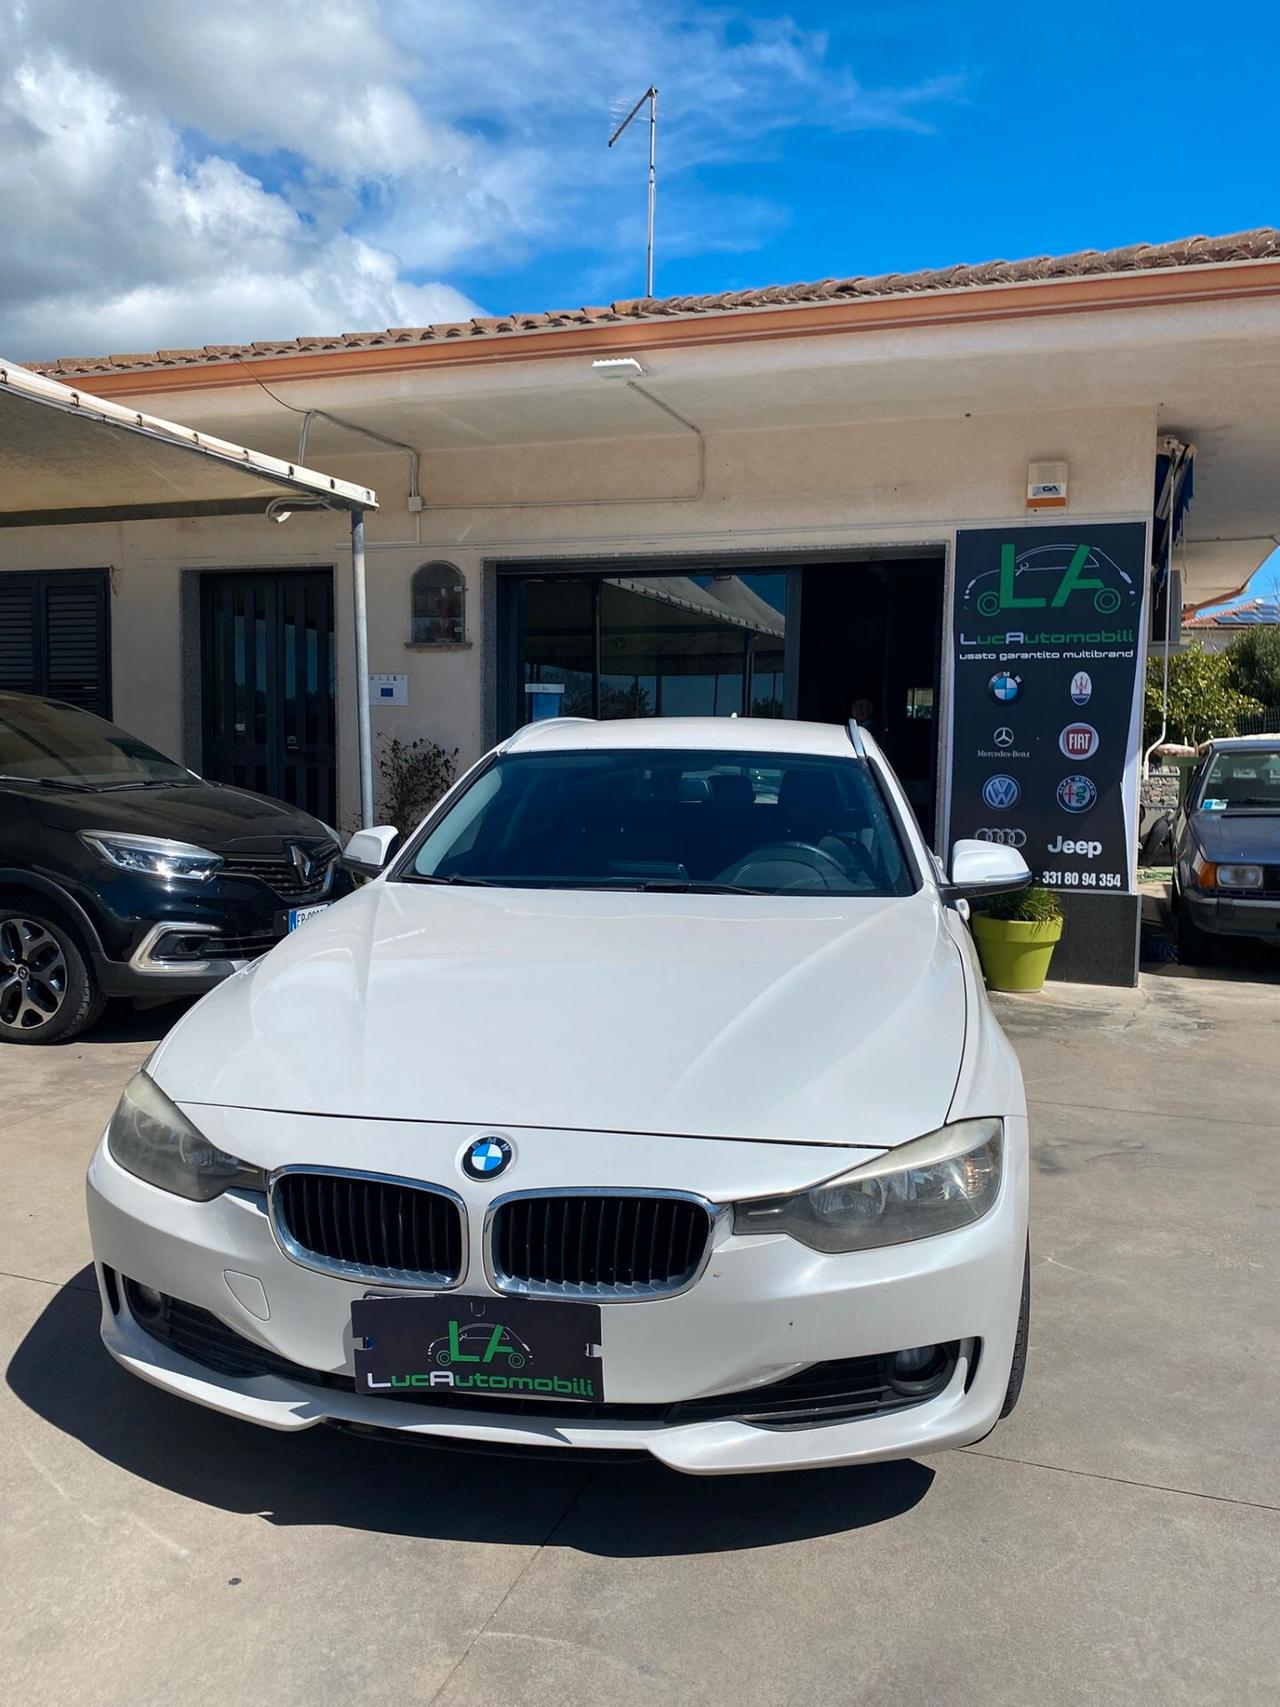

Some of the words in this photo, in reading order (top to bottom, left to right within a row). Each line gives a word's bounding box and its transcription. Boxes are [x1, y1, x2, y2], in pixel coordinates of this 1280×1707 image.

[960, 630, 1134, 645] LucAutomobili
[959, 652, 996, 660] usato
[999, 651, 1060, 661] garantito
[1063, 650, 1134, 659] multibrand
[1068, 733, 1091, 750] FIAT
[977, 750, 1030, 758] Mercedes-Benz
[1047, 835, 1102, 858] Jeep
[1042, 871, 1061, 884] 331
[1064, 872, 1079, 885] 80
[1081, 872, 1096, 886] 94
[1099, 873, 1121, 887] 354
[471, 1137, 511, 1151] BMW
[367, 1371, 594, 1397] LucAutomobili
